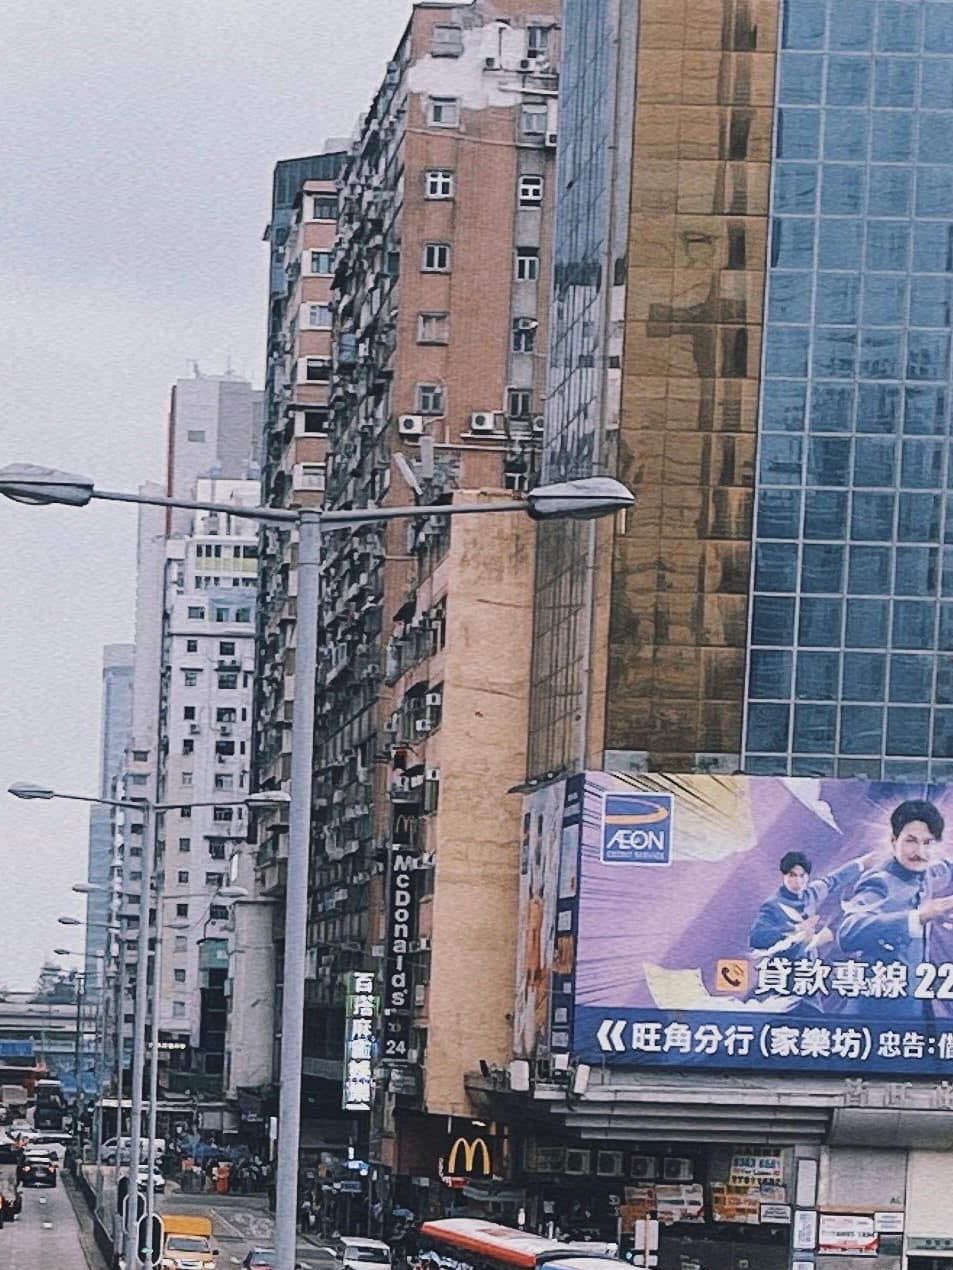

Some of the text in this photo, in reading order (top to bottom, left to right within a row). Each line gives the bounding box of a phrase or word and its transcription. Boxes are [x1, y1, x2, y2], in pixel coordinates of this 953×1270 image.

[391, 854, 412, 1007] McDonald's
[754, 957, 908, 998] 貸款專線
[385, 1040, 407, 1055] 24
